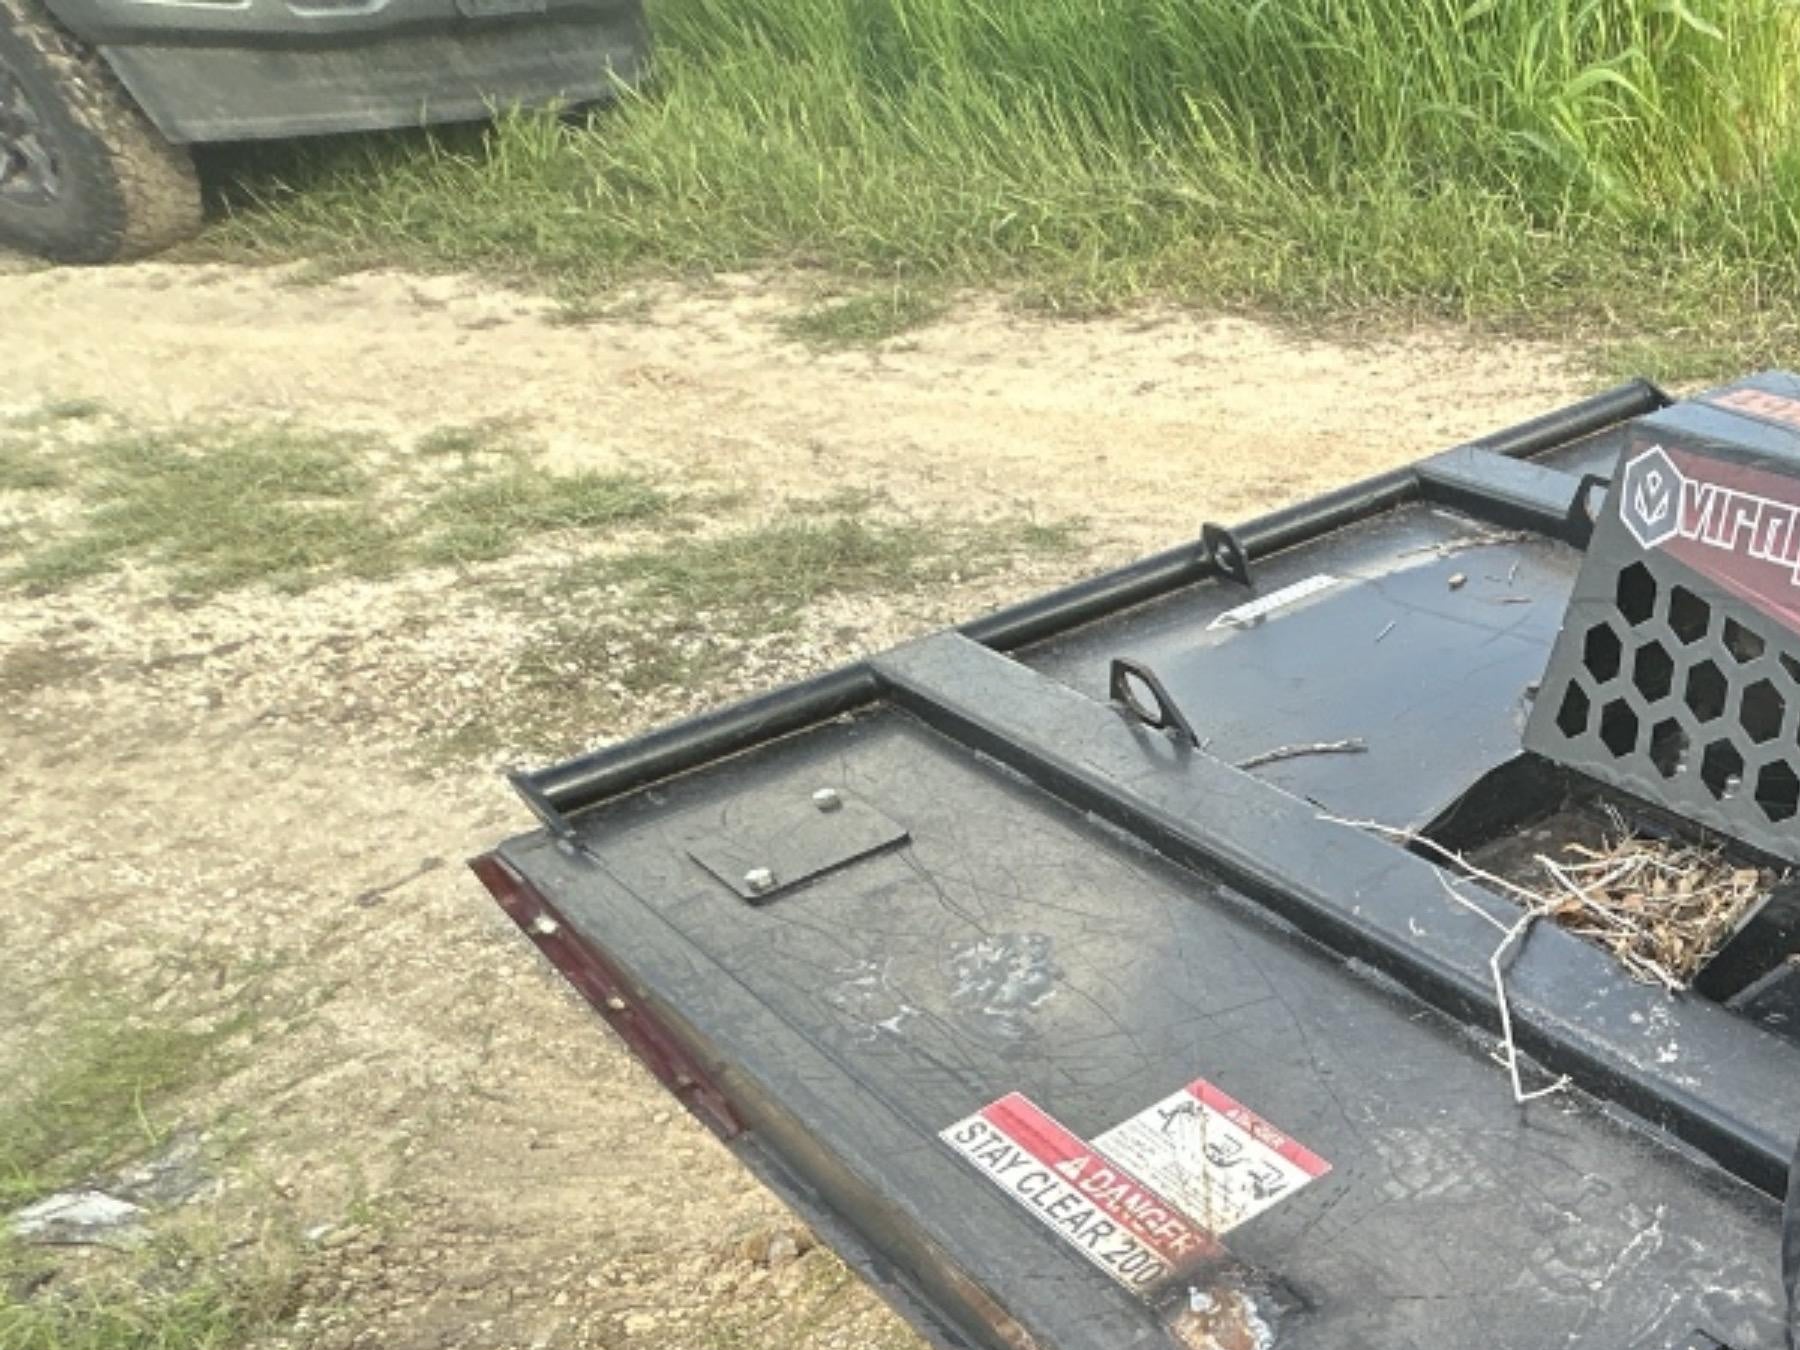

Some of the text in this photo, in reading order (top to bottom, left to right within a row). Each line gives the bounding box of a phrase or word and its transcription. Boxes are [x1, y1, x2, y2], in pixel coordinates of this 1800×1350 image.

[954, 1120, 1032, 1174] STAY
[1016, 1171, 1117, 1249] CLEAR
[1079, 1168, 1202, 1255] DANGER
